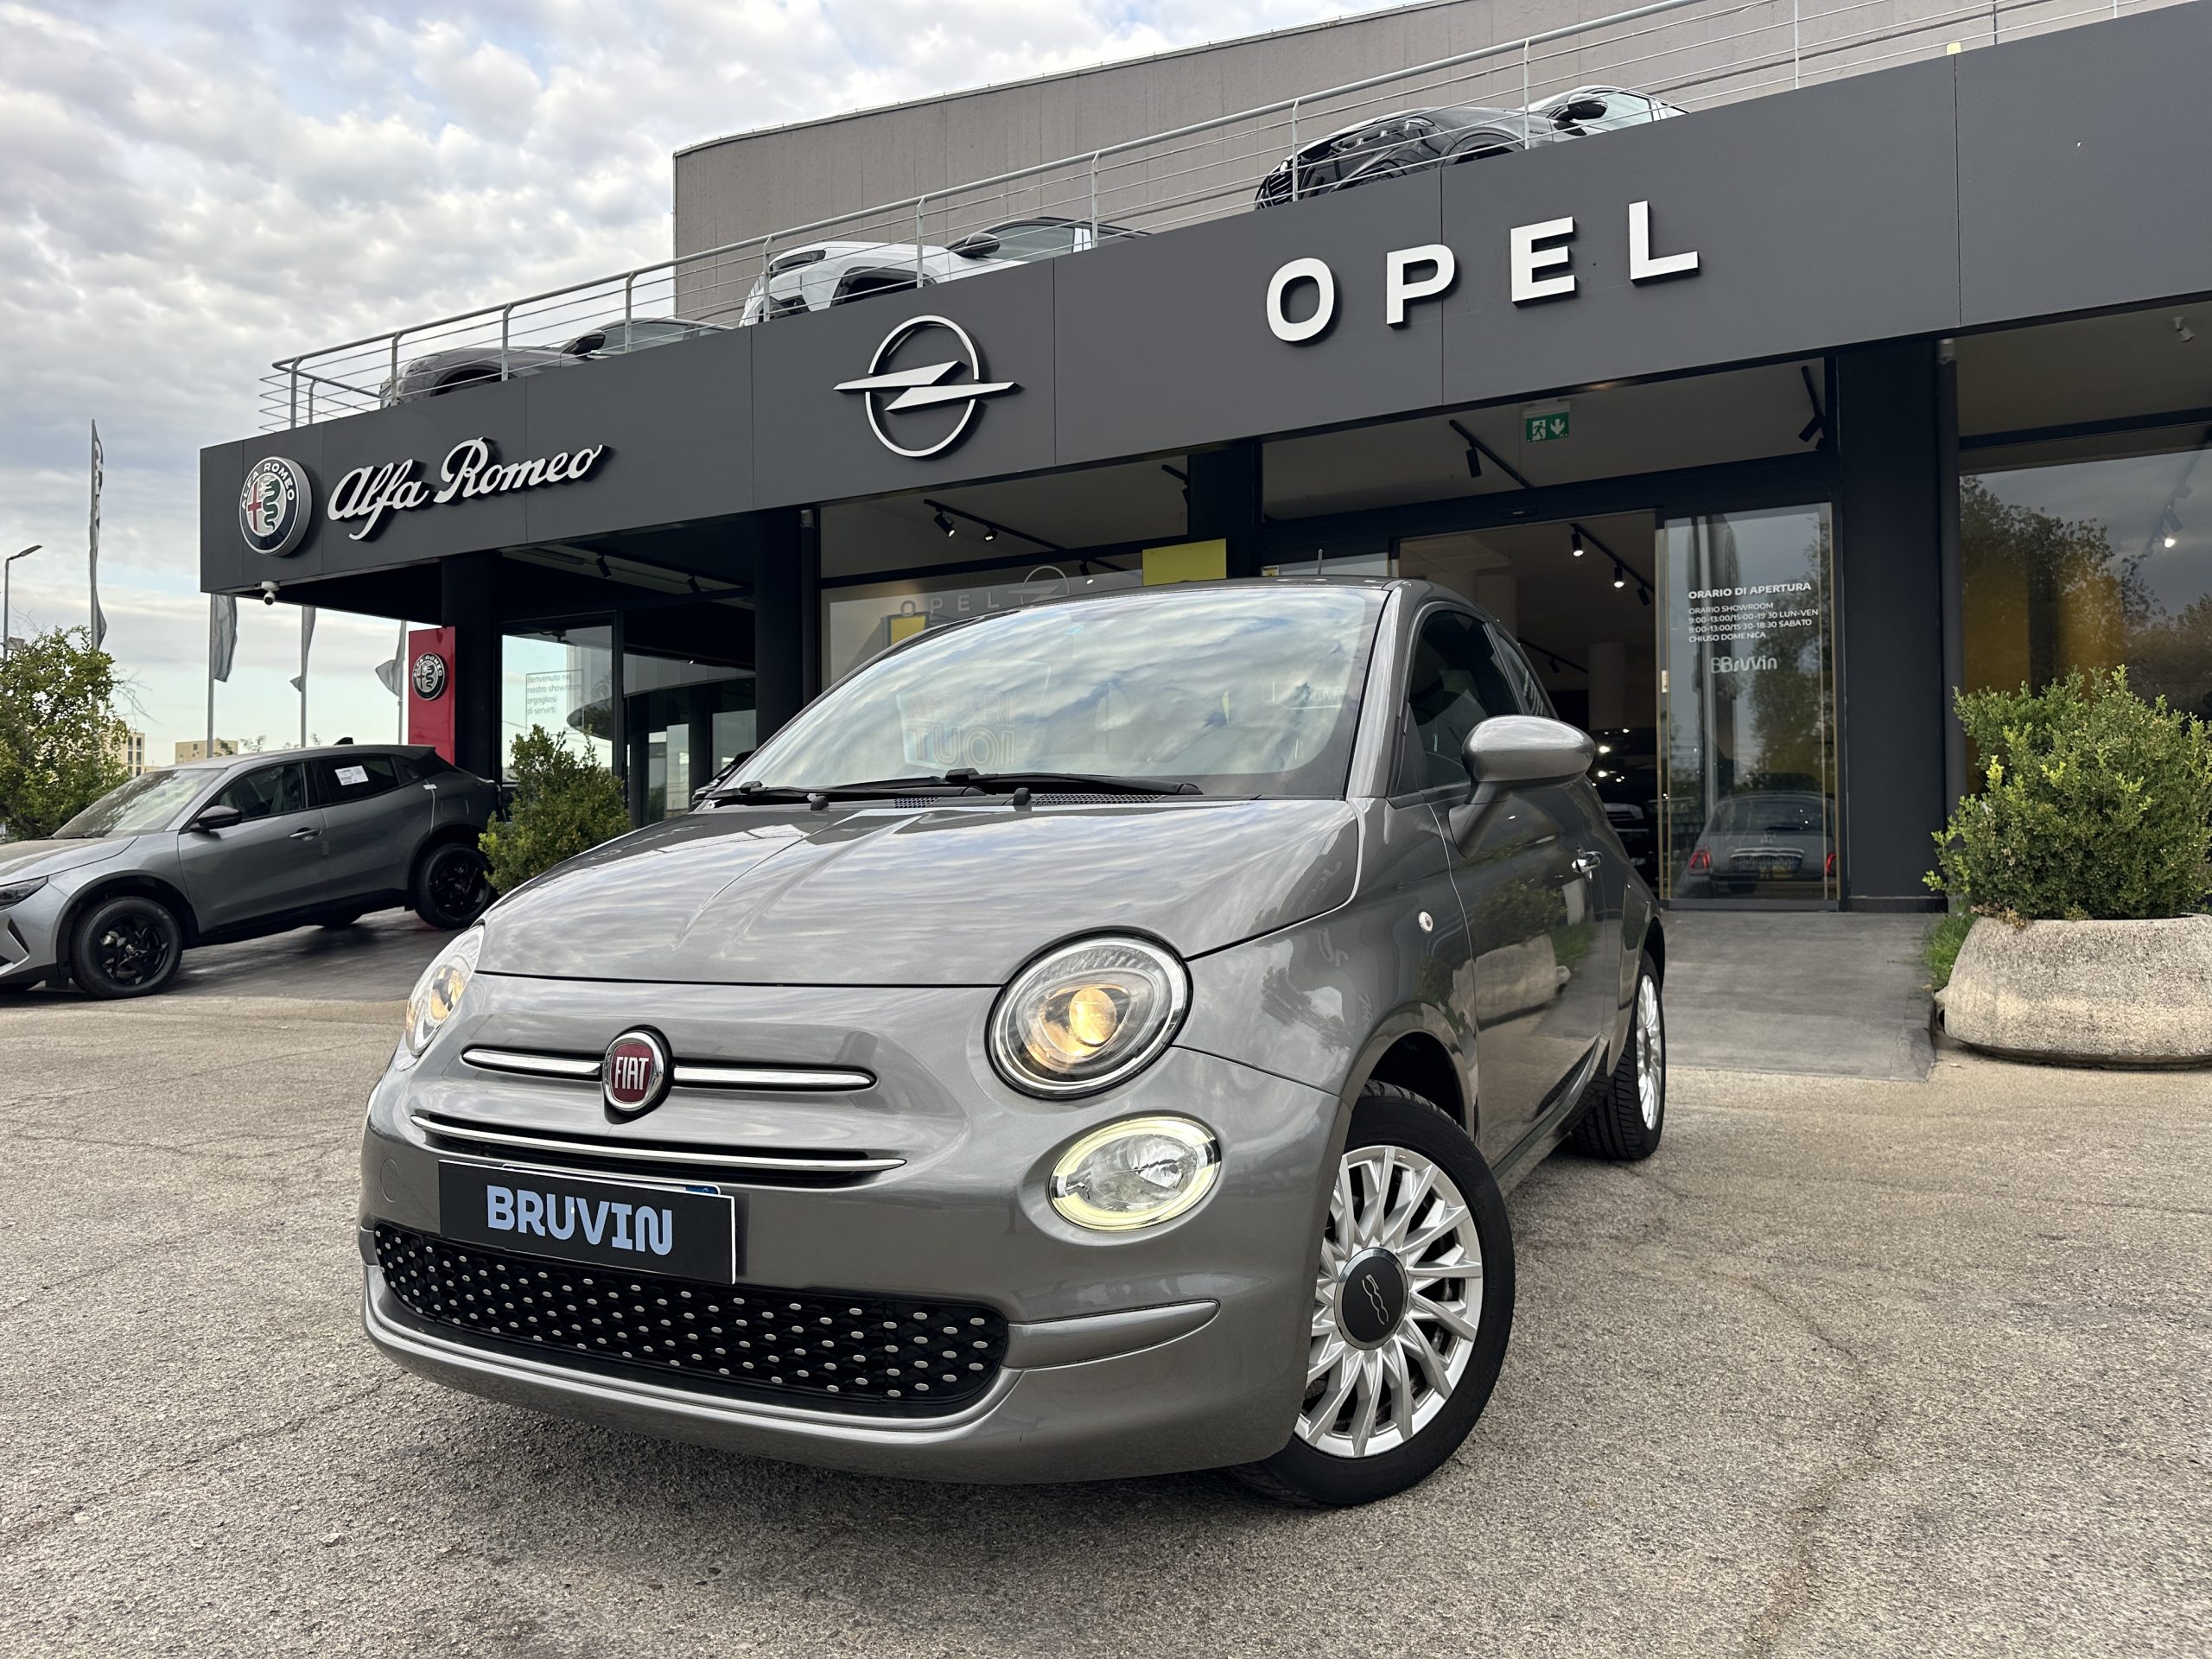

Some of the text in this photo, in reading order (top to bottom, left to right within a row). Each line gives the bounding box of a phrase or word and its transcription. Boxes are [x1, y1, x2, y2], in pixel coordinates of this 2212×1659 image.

[1266, 200, 1699, 342] OPEL
[241, 462, 296, 510] ALFA ROMEO
[327, 436, 603, 541] Alfa Romeo
[1688, 582, 1812, 600] ORARIO DI APERTURA
[899, 591, 1001, 617] OPEL
[1688, 602, 1774, 615] ORARIO SHOWROOM
[1779, 608, 1819, 619] LUN-VEN
[1778, 619, 1813, 628] SABATO
[1688, 631, 1766, 643] CHIUSO DOMENICA
[425, 655, 442, 677] ROMEO
[527, 674, 561, 683] Benvenuto
[527, 685, 547, 694] nostro
[614, 1056, 650, 1090] FIAT
[486, 1185, 673, 1255] BRUVIN
